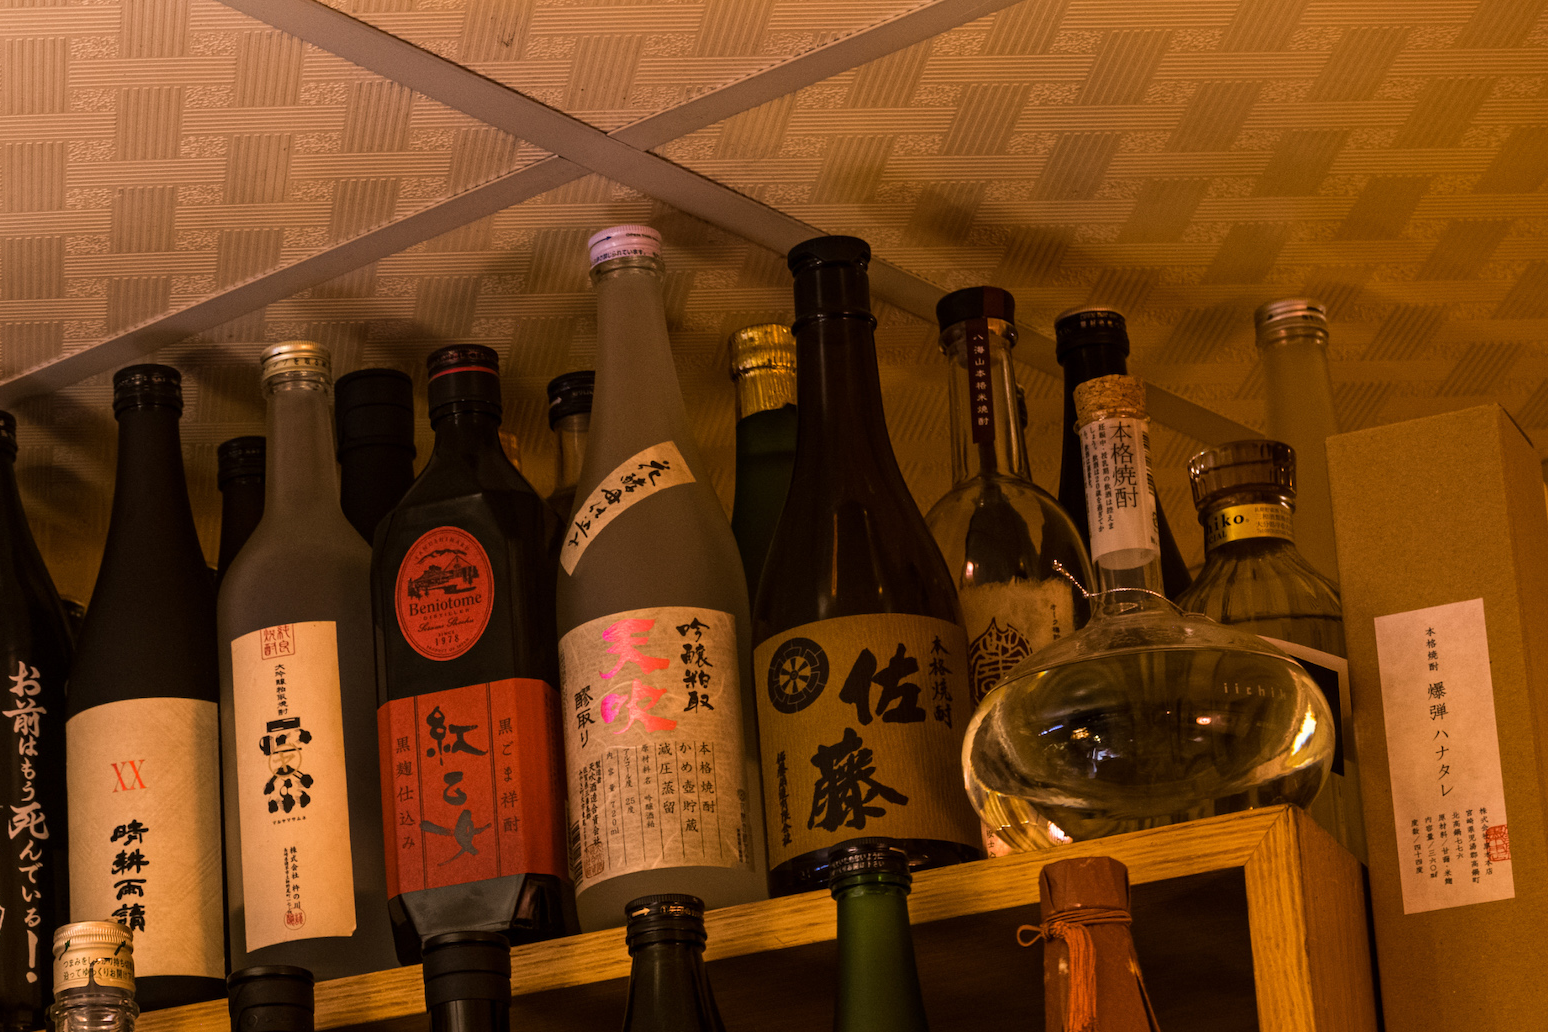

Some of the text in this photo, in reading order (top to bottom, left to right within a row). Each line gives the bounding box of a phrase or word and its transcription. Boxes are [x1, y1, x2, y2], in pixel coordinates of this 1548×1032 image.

[1109, 421, 1138, 509] 本格焼酎
[409, 594, 482, 617] Beniotome
[435, 634, 459, 646] 1978
[599, 618, 677, 735] 天吹
[676, 617, 714, 713] 吟醸粕取
[929, 635, 953, 729] 本格焼酎
[1425, 627, 1439, 672] 本格焼酎
[607, 751, 615, 792] 内容量
[641, 744, 651, 785] 原材料名
[808, 643, 926, 832] 佐藤
[110, 759, 147, 793] XX
[418, 705, 492, 867] 紅乙女
[658, 743, 675, 814] 減圧蒸留
[698, 742, 715, 813] 本格焼酎
